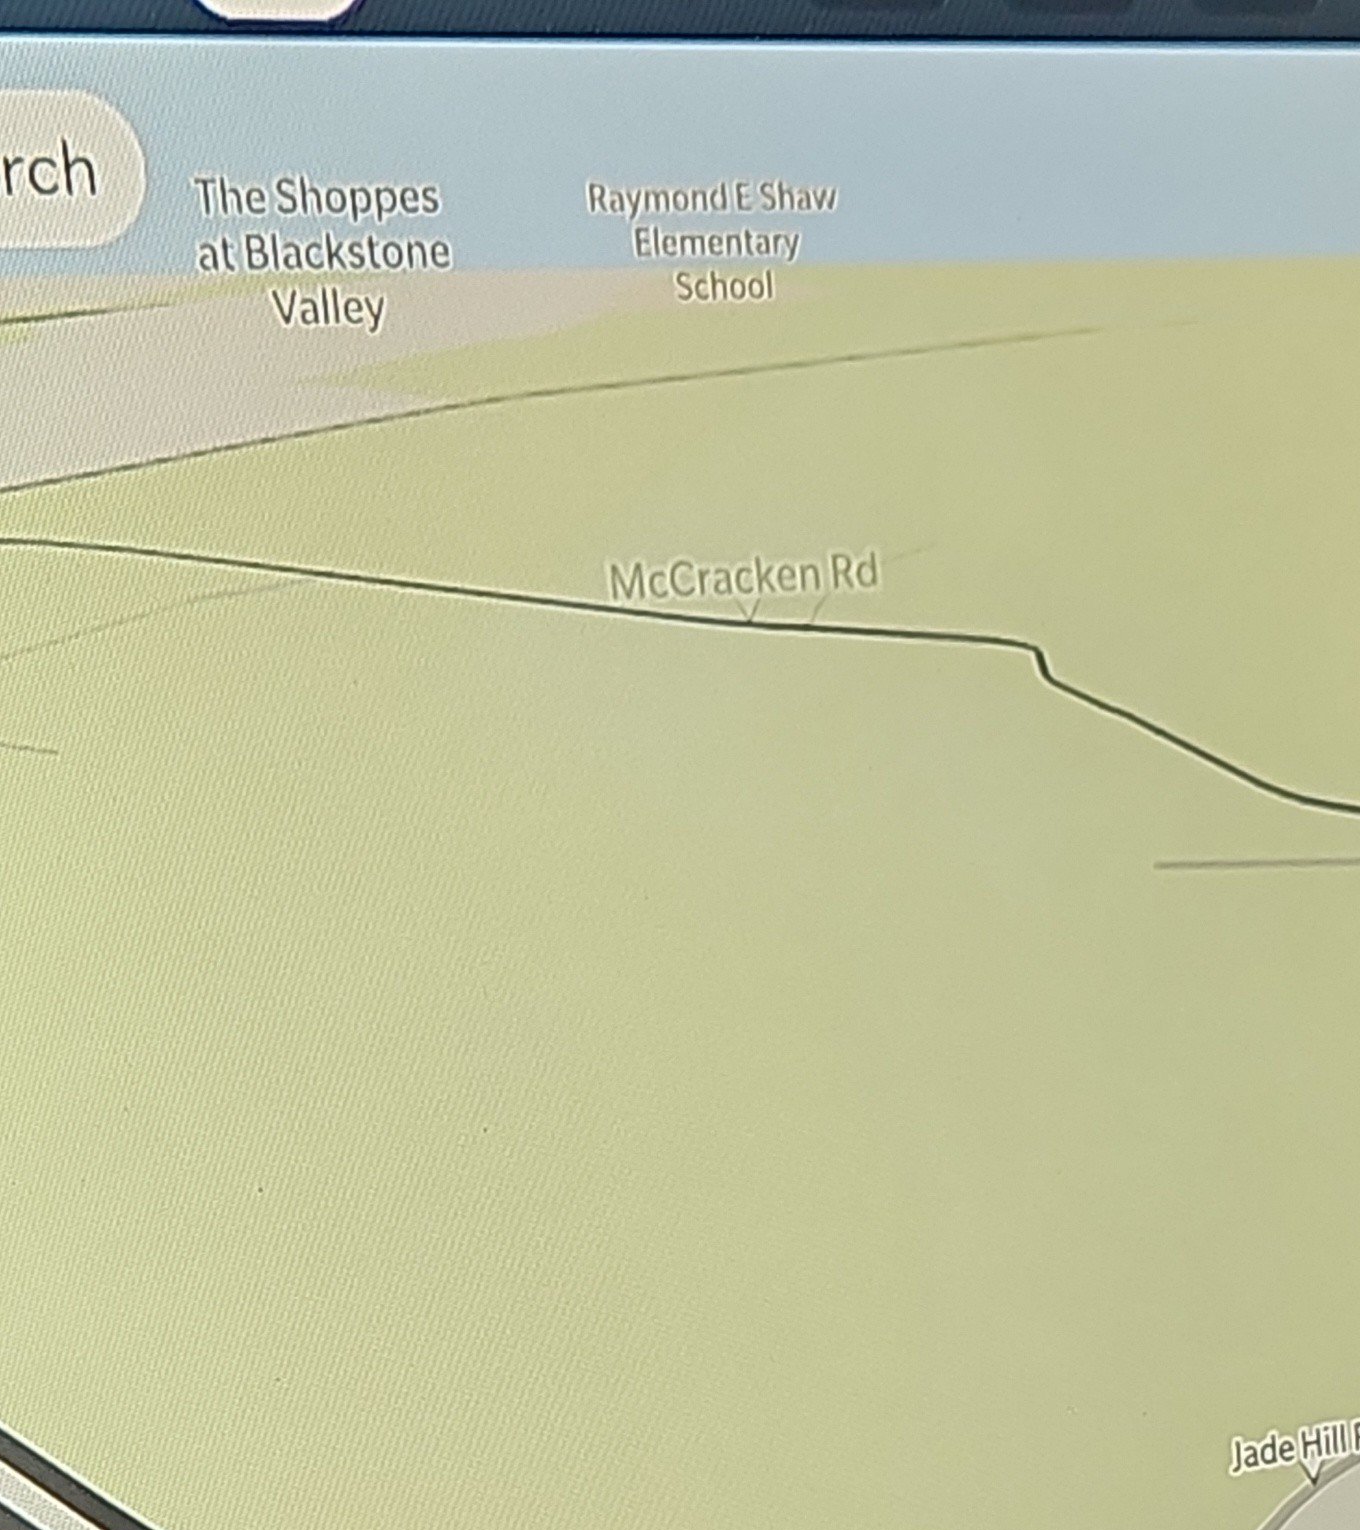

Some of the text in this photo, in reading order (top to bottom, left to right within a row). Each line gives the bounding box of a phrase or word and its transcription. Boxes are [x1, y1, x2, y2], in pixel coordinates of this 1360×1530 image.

[195, 178, 440, 222] The Shoppes
[588, 181, 838, 217] Raymond E Shaw
[199, 234, 452, 270] at Blackstone
[633, 227, 800, 263] Elementary
[676, 271, 774, 301] School
[272, 290, 385, 332] Valley
[609, 552, 878, 602] McCracken Rd
[1232, 1434, 1295, 1473] Jade
[1300, 1424, 1346, 1460] Hill
